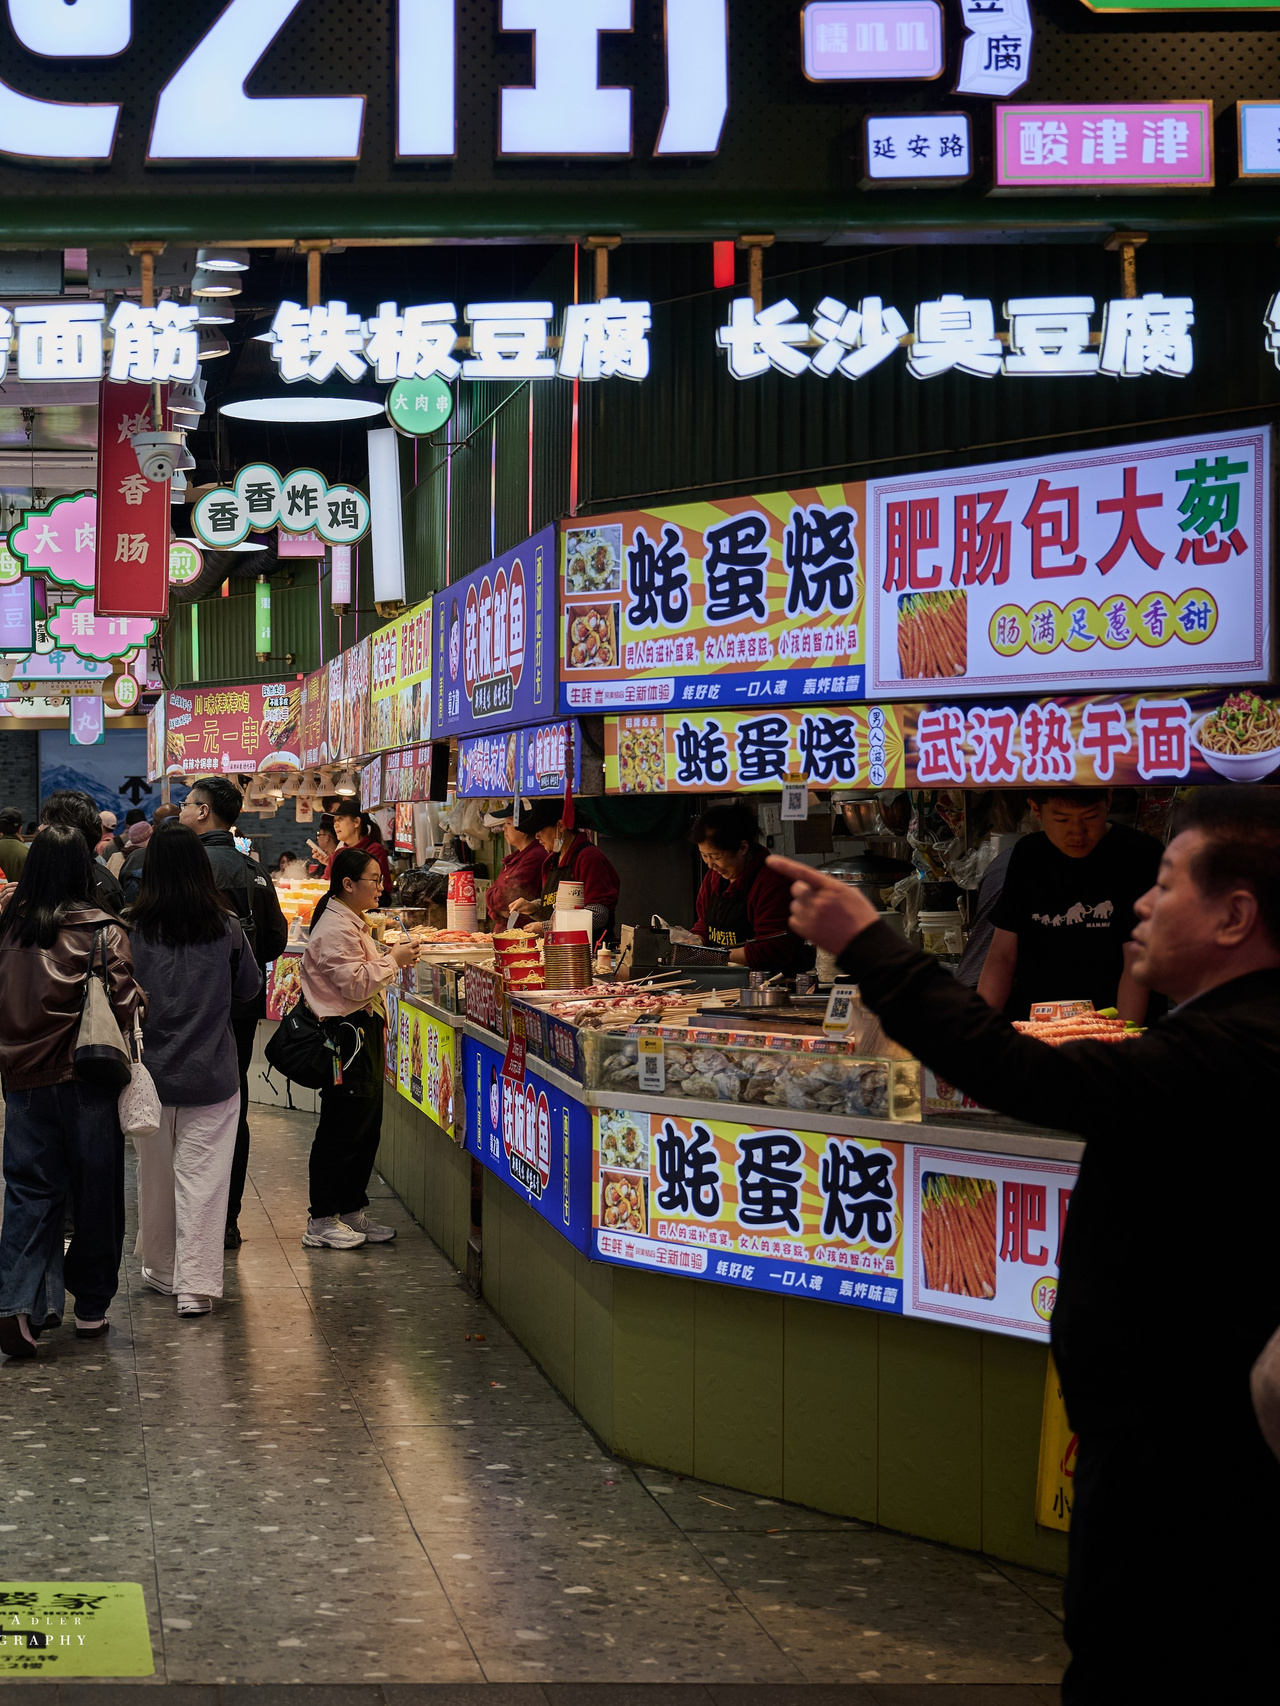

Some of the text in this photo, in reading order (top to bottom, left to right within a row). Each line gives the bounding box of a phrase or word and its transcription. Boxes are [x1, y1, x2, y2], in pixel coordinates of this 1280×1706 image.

[873, 133, 966, 160] 延安路
[1020, 117, 1189, 166] 酸津津
[270, 297, 651, 384] 铁板豆腐
[717, 294, 1195, 379] 长沙臭豆腐
[394, 393, 449, 413] 大肉串
[207, 481, 359, 532] 香香炸鸡
[883, 456, 1248, 592] 肥肠包大葱
[627, 508, 856, 628] 蚝蛋烧
[465, 583, 524, 682] 铁板鱿鱼
[194, 691, 250, 715] 川味棒棒鸡
[570, 687, 592, 703] 生蚝
[625, 684, 670, 702] 全新体验
[682, 685, 721, 700] 蚝好吃
[802, 675, 861, 695] 轰炸味蕾
[185, 716, 259, 754] 一元一串
[677, 715, 856, 782] 蚝蛋烧
[919, 700, 1191, 781] 武汉热干面
[503, 1084, 549, 1181] 铁板鱿鱼
[655, 1122, 895, 1245] 蚝蛋烧
[601, 1236, 623, 1255] 生蚝
[656, 1247, 703, 1271] 全新体验
[715, 1260, 754, 1282] 蚝好吃
[838, 1280, 899, 1304] 轰炸味蕾
